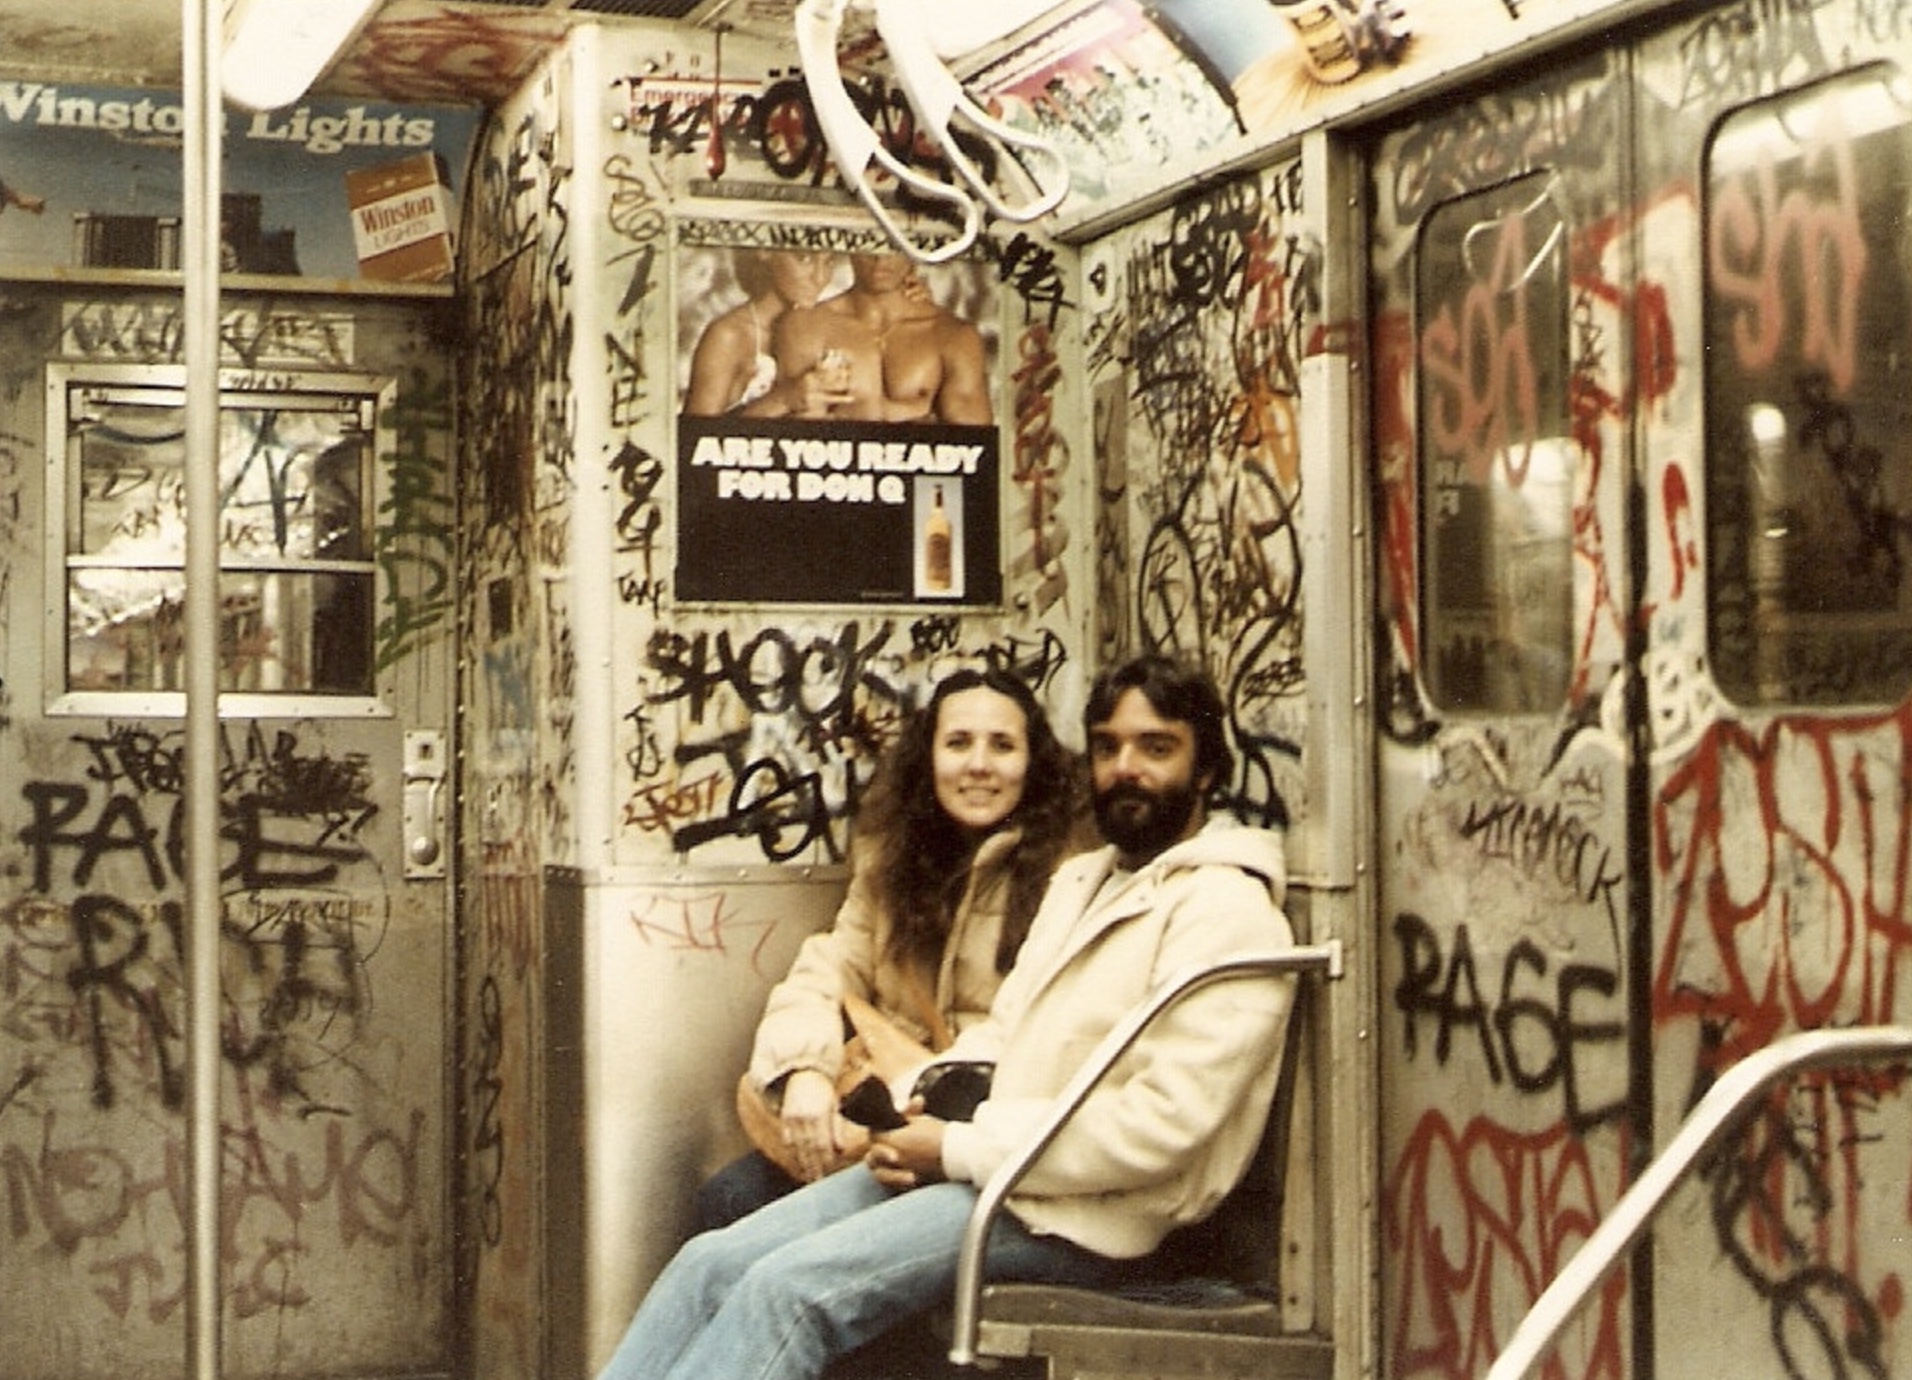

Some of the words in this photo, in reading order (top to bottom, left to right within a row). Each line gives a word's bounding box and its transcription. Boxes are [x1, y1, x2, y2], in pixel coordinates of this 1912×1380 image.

[0, 80, 229, 137] Winsto
[246, 106, 435, 154] Lights
[361, 196, 436, 236] Winston
[691, 437, 774, 467] ARE
[779, 440, 853, 470] YOU
[858, 443, 984, 474] READY
[718, 469, 792, 500] FOR
[797, 472, 874, 502] DON
[878, 474, 906, 504] Q
